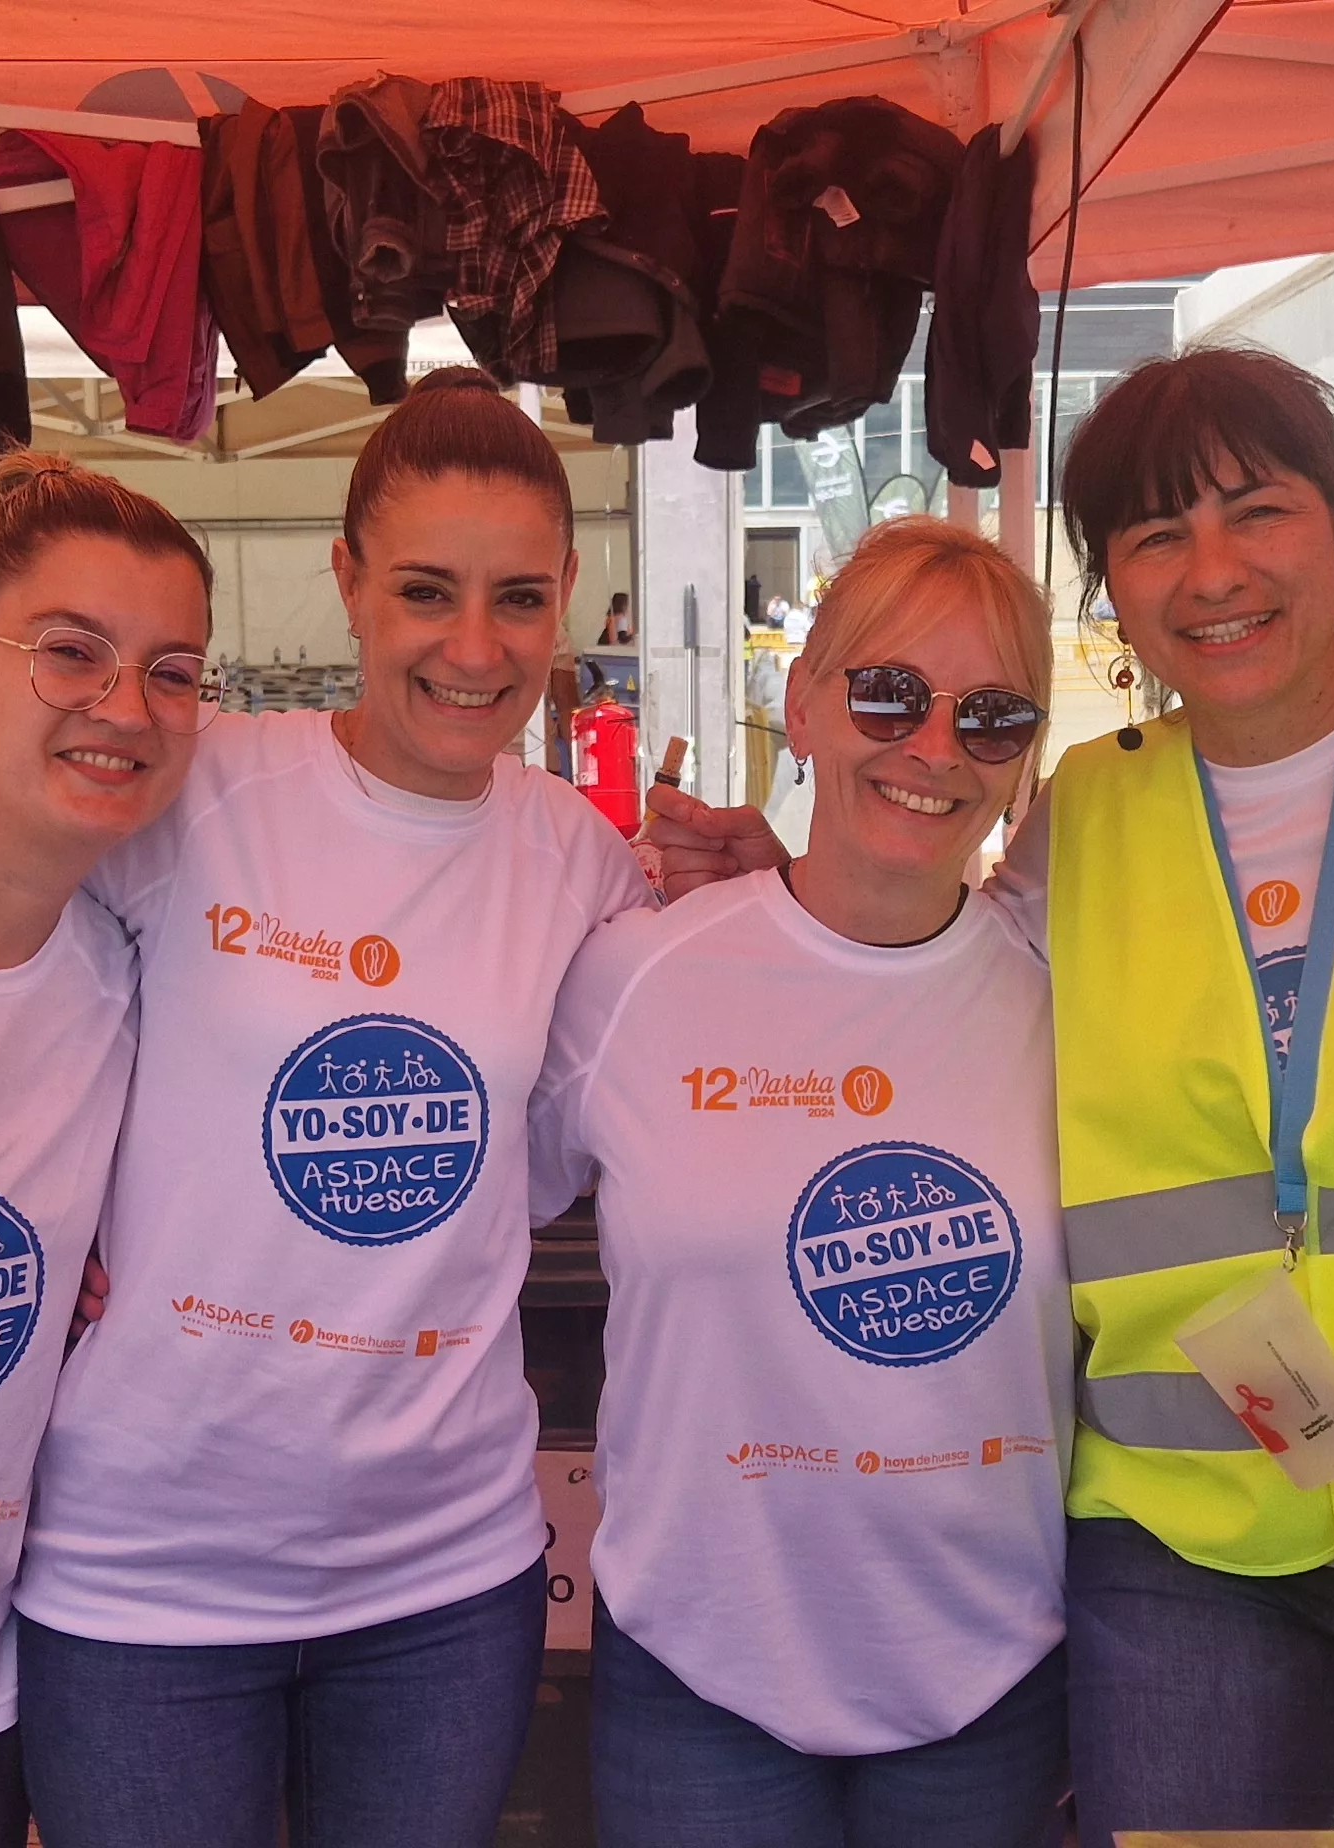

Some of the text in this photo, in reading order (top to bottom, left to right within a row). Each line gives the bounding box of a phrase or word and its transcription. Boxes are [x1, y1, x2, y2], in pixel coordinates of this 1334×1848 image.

[261, 912, 344, 958] Marcha
[257, 944, 341, 970] ASPACE HUESCA
[311, 968, 339, 981] 2024
[748, 1066, 836, 1094] Marcha
[749, 1095, 835, 1107] ASPACE HUESCA
[808, 1108, 835, 1118] 2024
[302, 1153, 456, 1192] ASPACE
[320, 1186, 439, 1214] Huesca
[839, 1265, 993, 1321] ASPACE
[195, 1299, 275, 1329] ASPACE
[858, 1300, 979, 1341] Huesca
[317, 1328, 348, 1344] hoya
[350, 1334, 366, 1346] de
[368, 1335, 406, 1349] huesca
[751, 1442, 839, 1463] ASPACE
[884, 1456, 914, 1468] hoya
[916, 1454, 930, 1465] de
[932, 1450, 969, 1463] huesca
